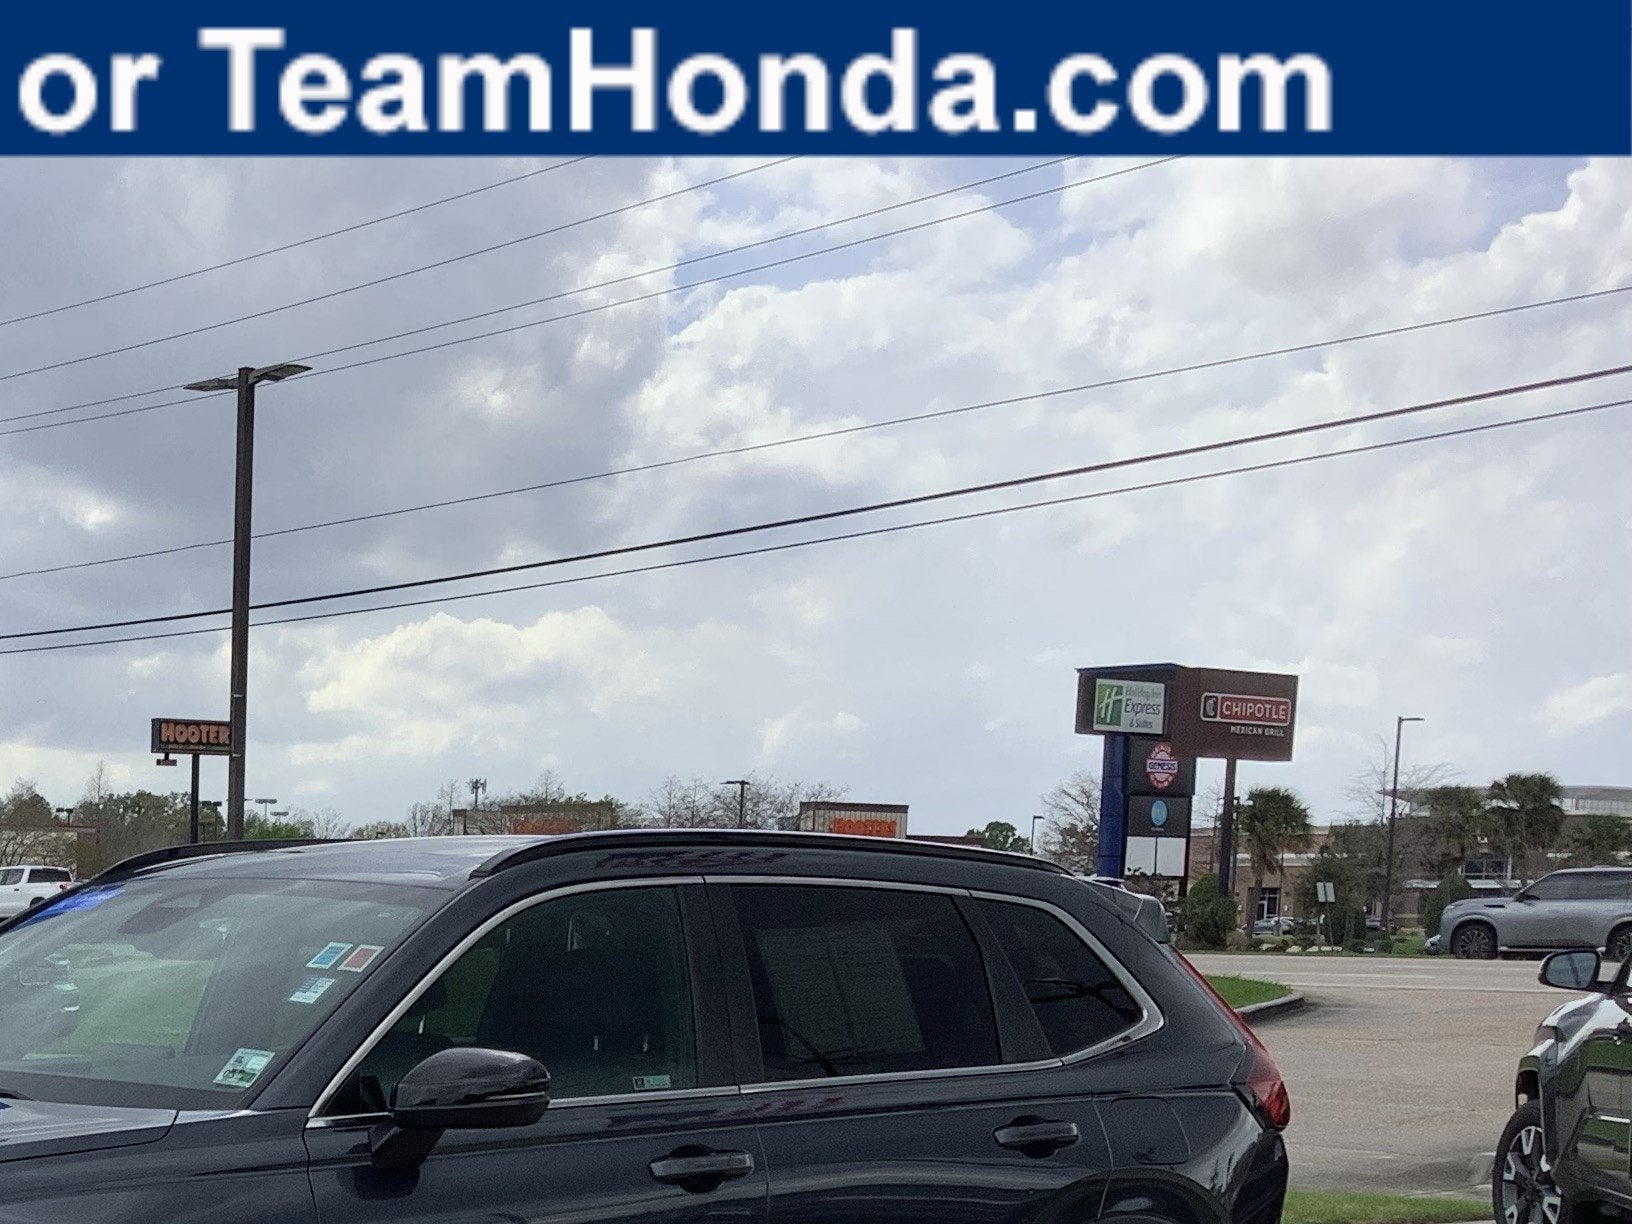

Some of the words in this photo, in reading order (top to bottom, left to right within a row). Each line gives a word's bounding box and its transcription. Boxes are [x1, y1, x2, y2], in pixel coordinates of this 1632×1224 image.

[1125, 698, 1161, 717] Express
[1222, 701, 1287, 720] CHIPOTLE
[160, 722, 231, 744] HOOTER
[1231, 725, 1263, 735] MEXICAN
